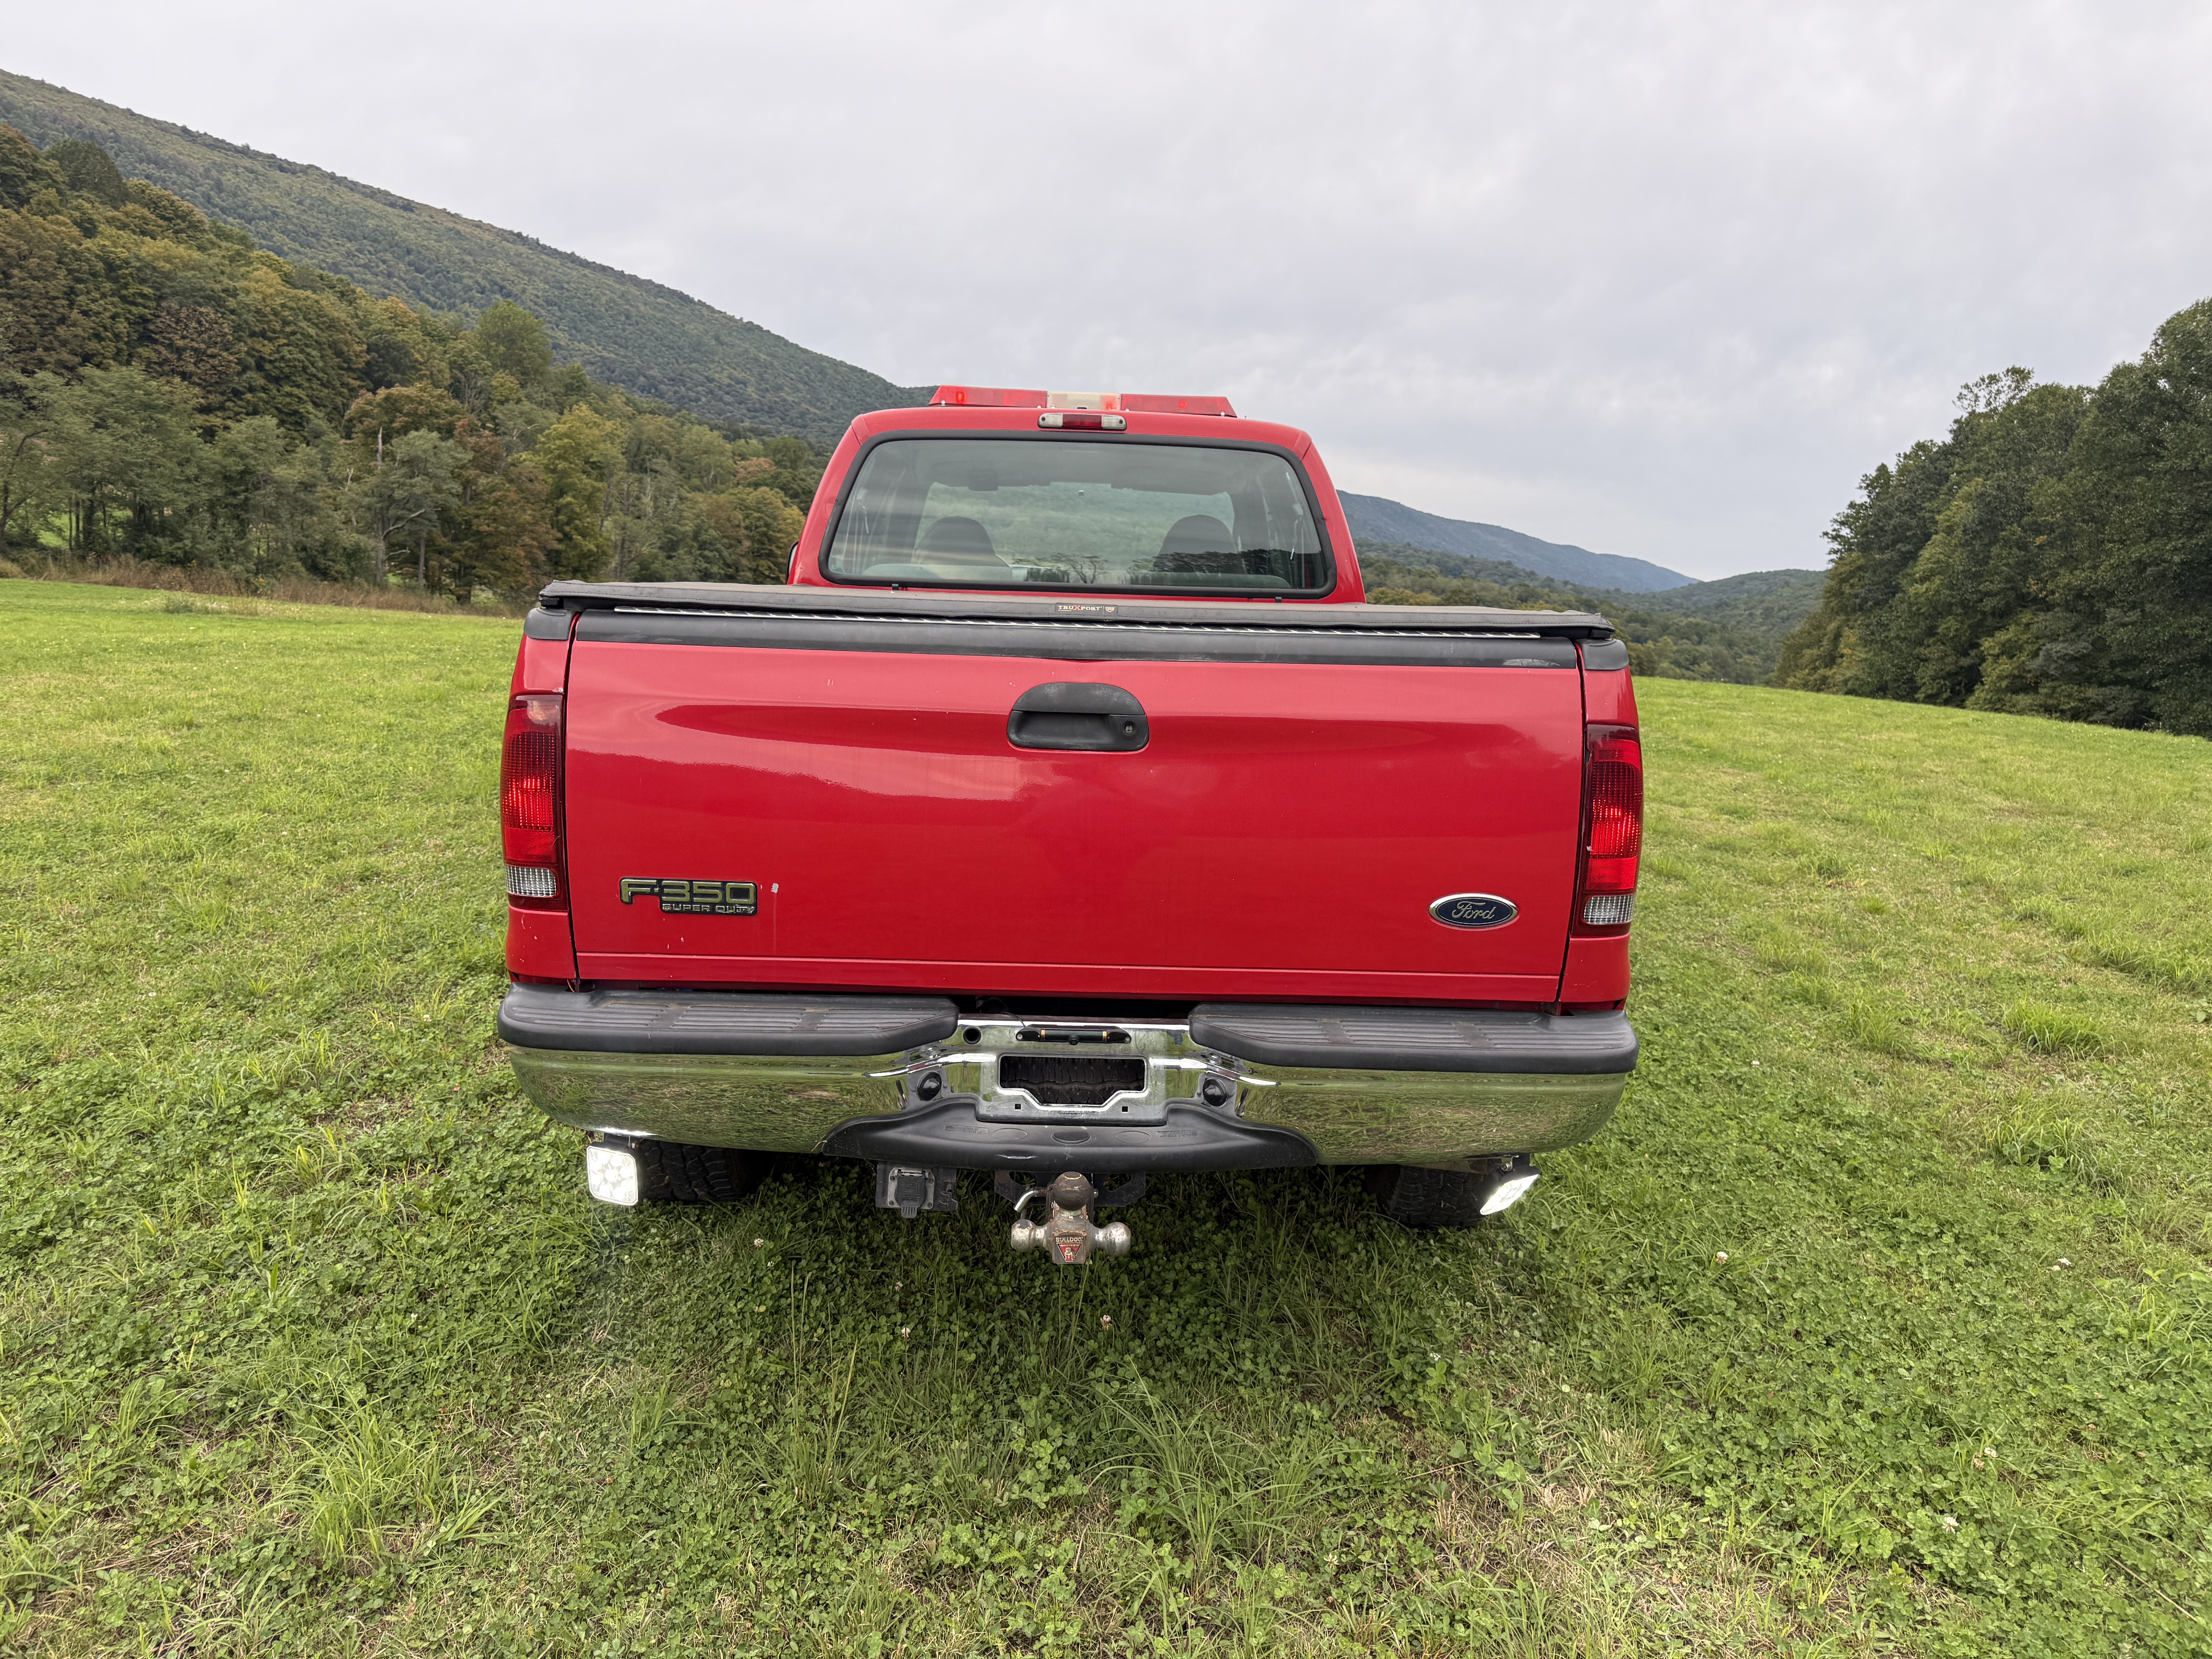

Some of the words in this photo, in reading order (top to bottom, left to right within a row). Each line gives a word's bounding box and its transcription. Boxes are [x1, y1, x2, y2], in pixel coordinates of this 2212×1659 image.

[620, 879, 755, 904] F-350
[662, 904, 710, 912] SUPER
[715, 905, 755, 914] DUTY
[1452, 901, 1496, 919] Ford
